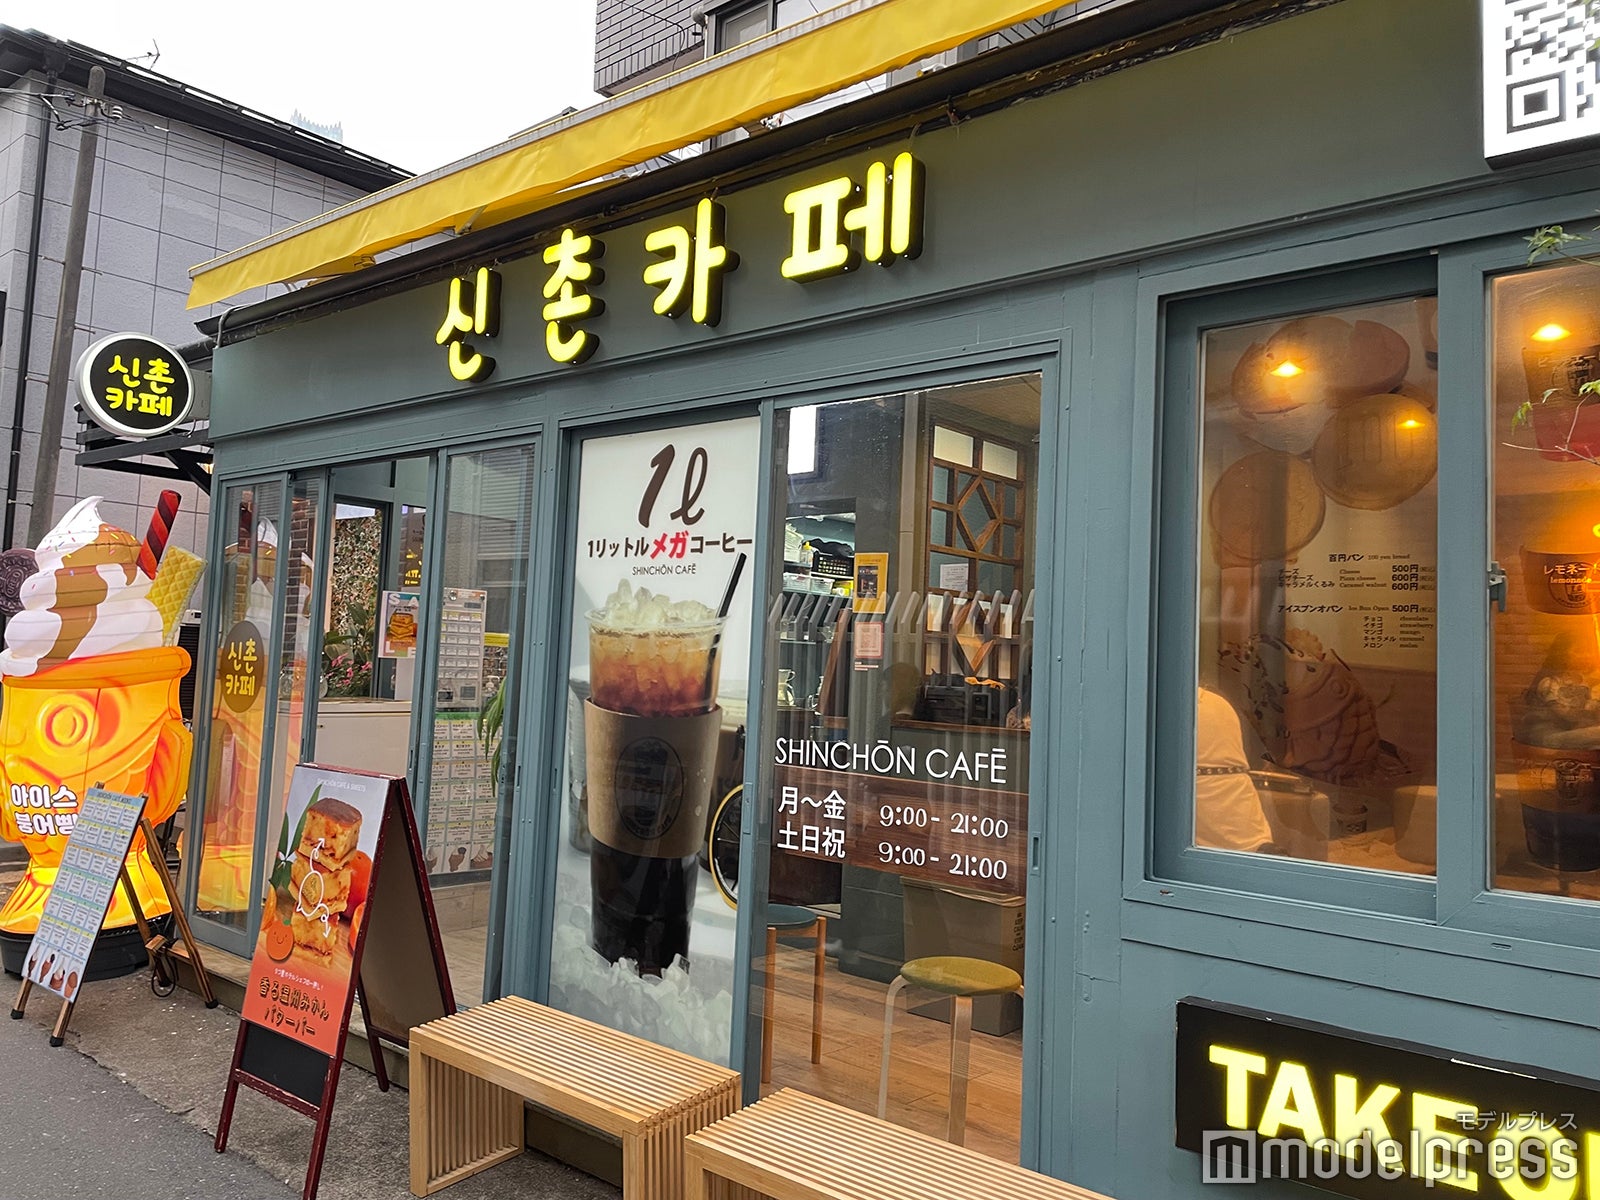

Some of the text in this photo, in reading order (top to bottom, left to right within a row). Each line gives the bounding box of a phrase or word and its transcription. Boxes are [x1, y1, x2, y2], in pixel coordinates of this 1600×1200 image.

[108, 355, 175, 394] 신촌
[105, 387, 173, 417] 카페
[587, 530, 752, 560] 1リットルメガコーヒー
[1329, 553, 1364, 562] 百円パン
[1392, 564, 1418, 573] 500円
[1392, 573, 1418, 582] 600円
[1392, 582, 1418, 591] 600円
[1392, 604, 1418, 613] 500円
[228, 638, 257, 674] 신촌
[225, 674, 256, 696] 카페
[774, 737, 1007, 784] SHINCHŌN CAFĒ
[11, 785, 78, 808] 아이스
[950, 812, 1009, 839] 21:00
[777, 821, 846, 859] 土日祝
[949, 853, 1008, 880] 21:00
[1208, 1044, 1479, 1192] TAKE
